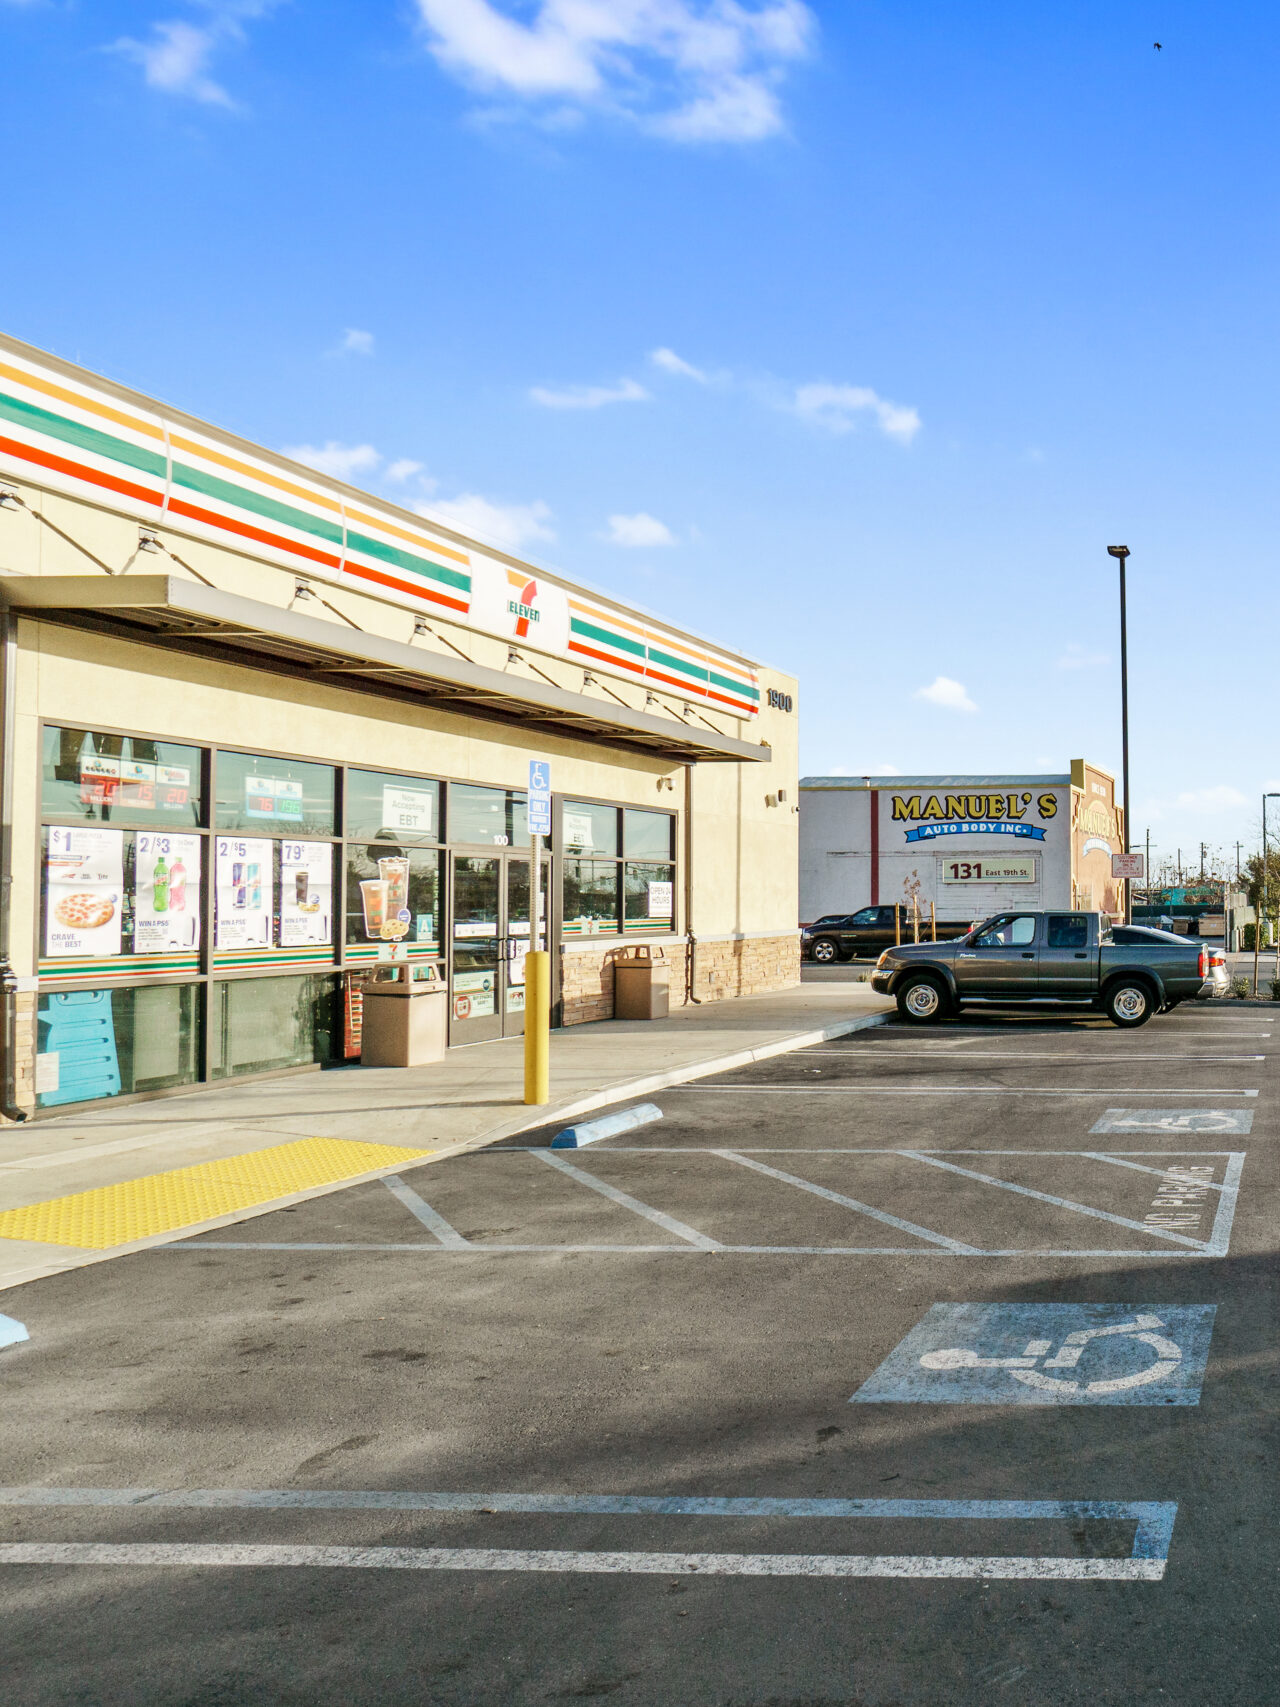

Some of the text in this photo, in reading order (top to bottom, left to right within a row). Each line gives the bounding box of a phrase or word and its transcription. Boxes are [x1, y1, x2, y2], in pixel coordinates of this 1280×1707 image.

[766, 687, 793, 713] 1900
[892, 792, 1058, 822] MANUEL'S
[400, 814, 418, 826] EBT
[924, 823, 1028, 835] AUTO BODY INC.
[494, 835, 508, 846] 100
[950, 863, 983, 880] 131
[1003, 868, 1018, 876] 19th
[420, 920, 429, 932] A
[51, 933, 75, 941] CRAVE
[65, 940, 81, 948] BEST
[1140, 1166, 1215, 1231] NO PARKING
